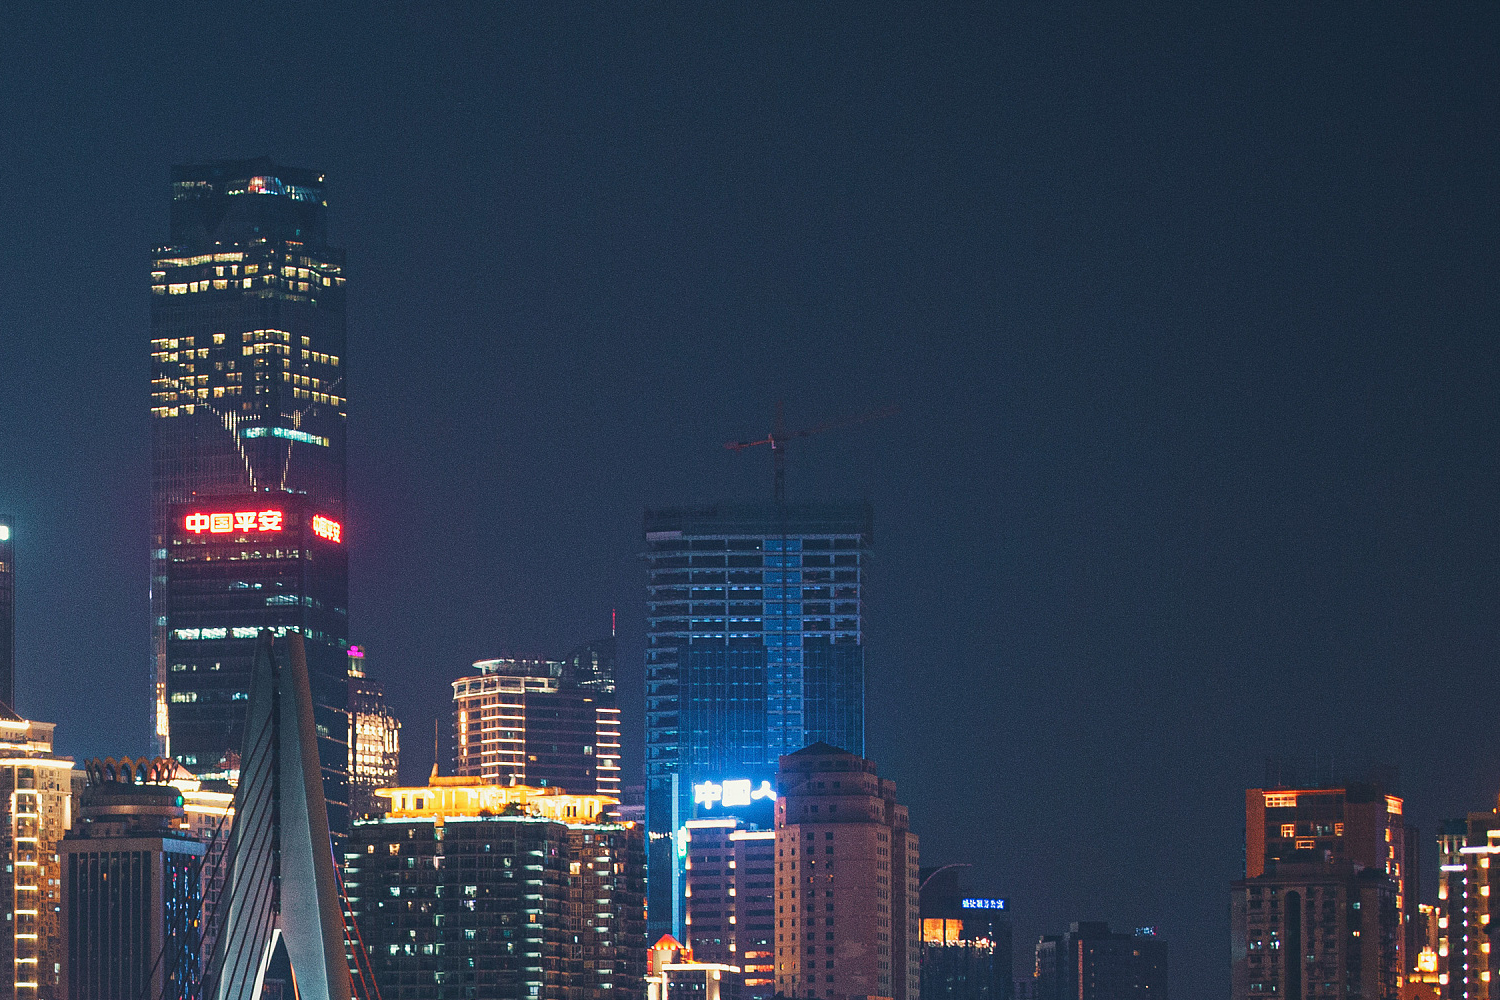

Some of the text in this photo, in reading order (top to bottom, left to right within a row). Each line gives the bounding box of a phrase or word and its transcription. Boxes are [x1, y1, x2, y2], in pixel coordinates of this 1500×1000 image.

[185, 510, 283, 534] 中国平安
[312, 514, 342, 544] 中国平安
